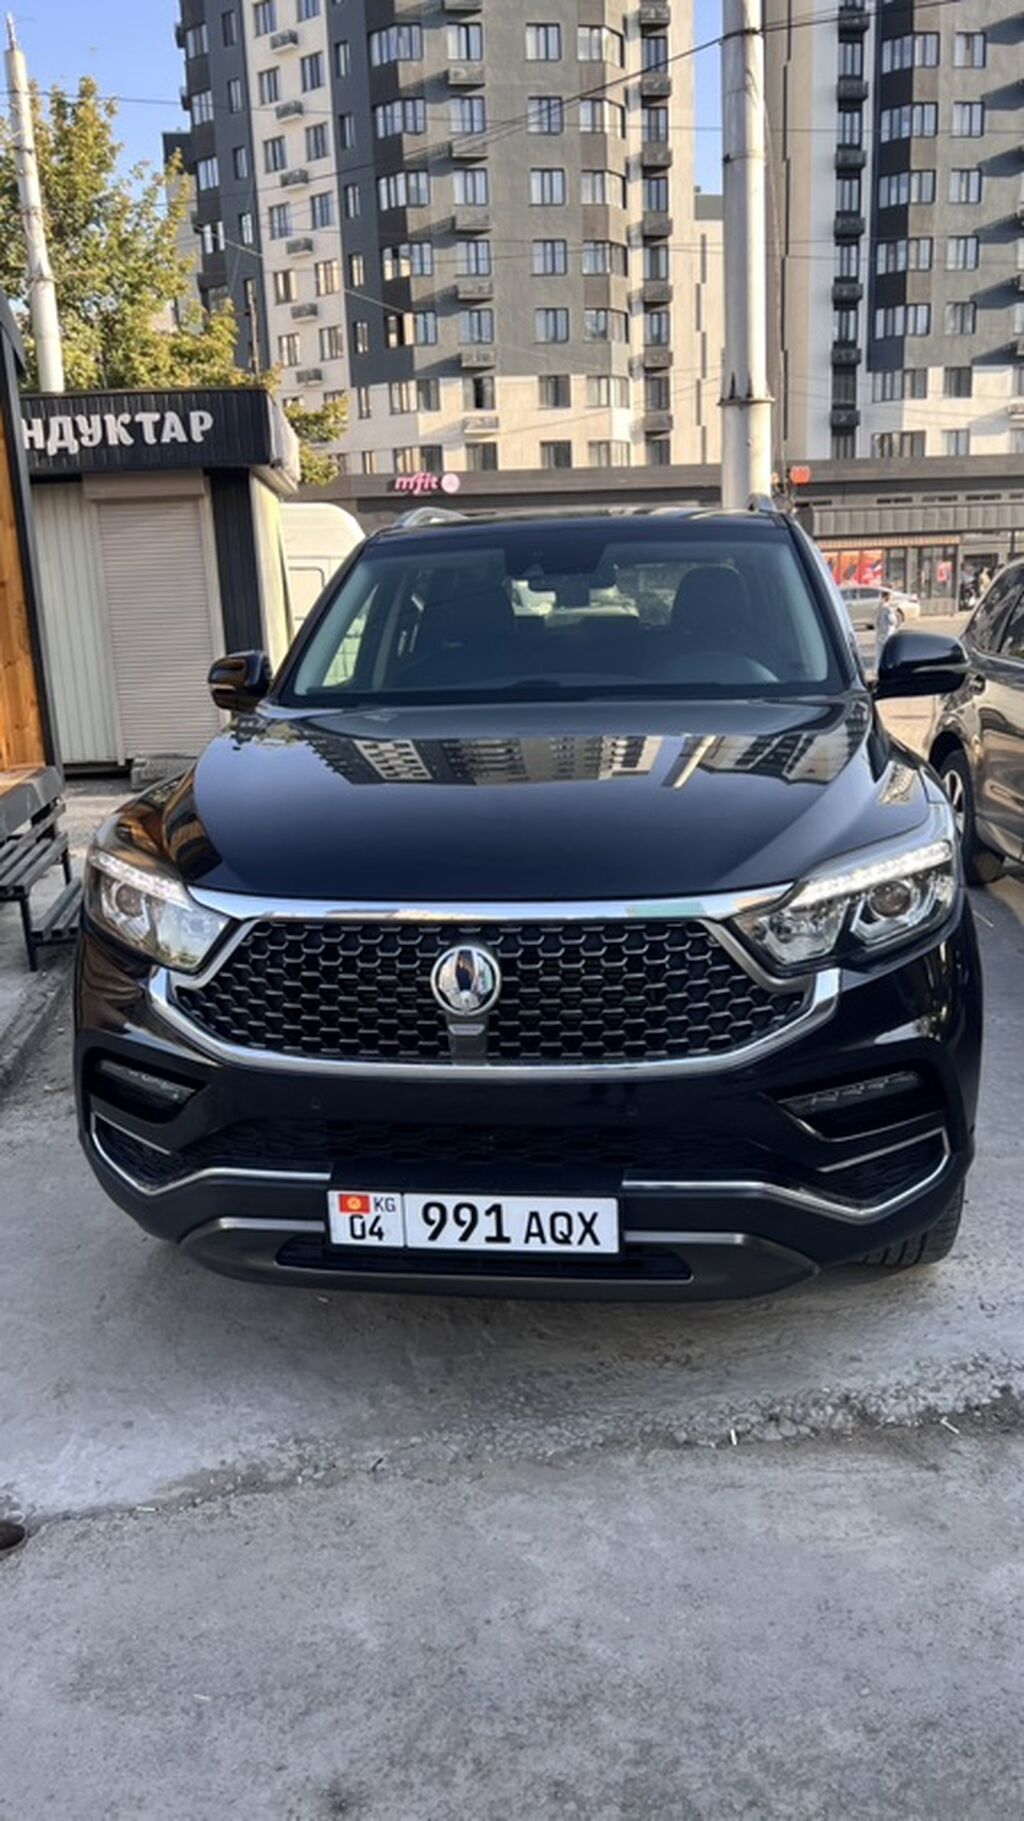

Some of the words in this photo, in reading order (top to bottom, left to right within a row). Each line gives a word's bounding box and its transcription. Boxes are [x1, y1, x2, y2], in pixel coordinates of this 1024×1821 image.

[21, 411, 213, 456] НДУКТАР
[394, 472, 439, 495] mfit
[374, 1197, 396, 1212] KG
[349, 1215, 384, 1241] 04
[421, 1202, 511, 1244] 991
[524, 1211, 601, 1246] AQX
